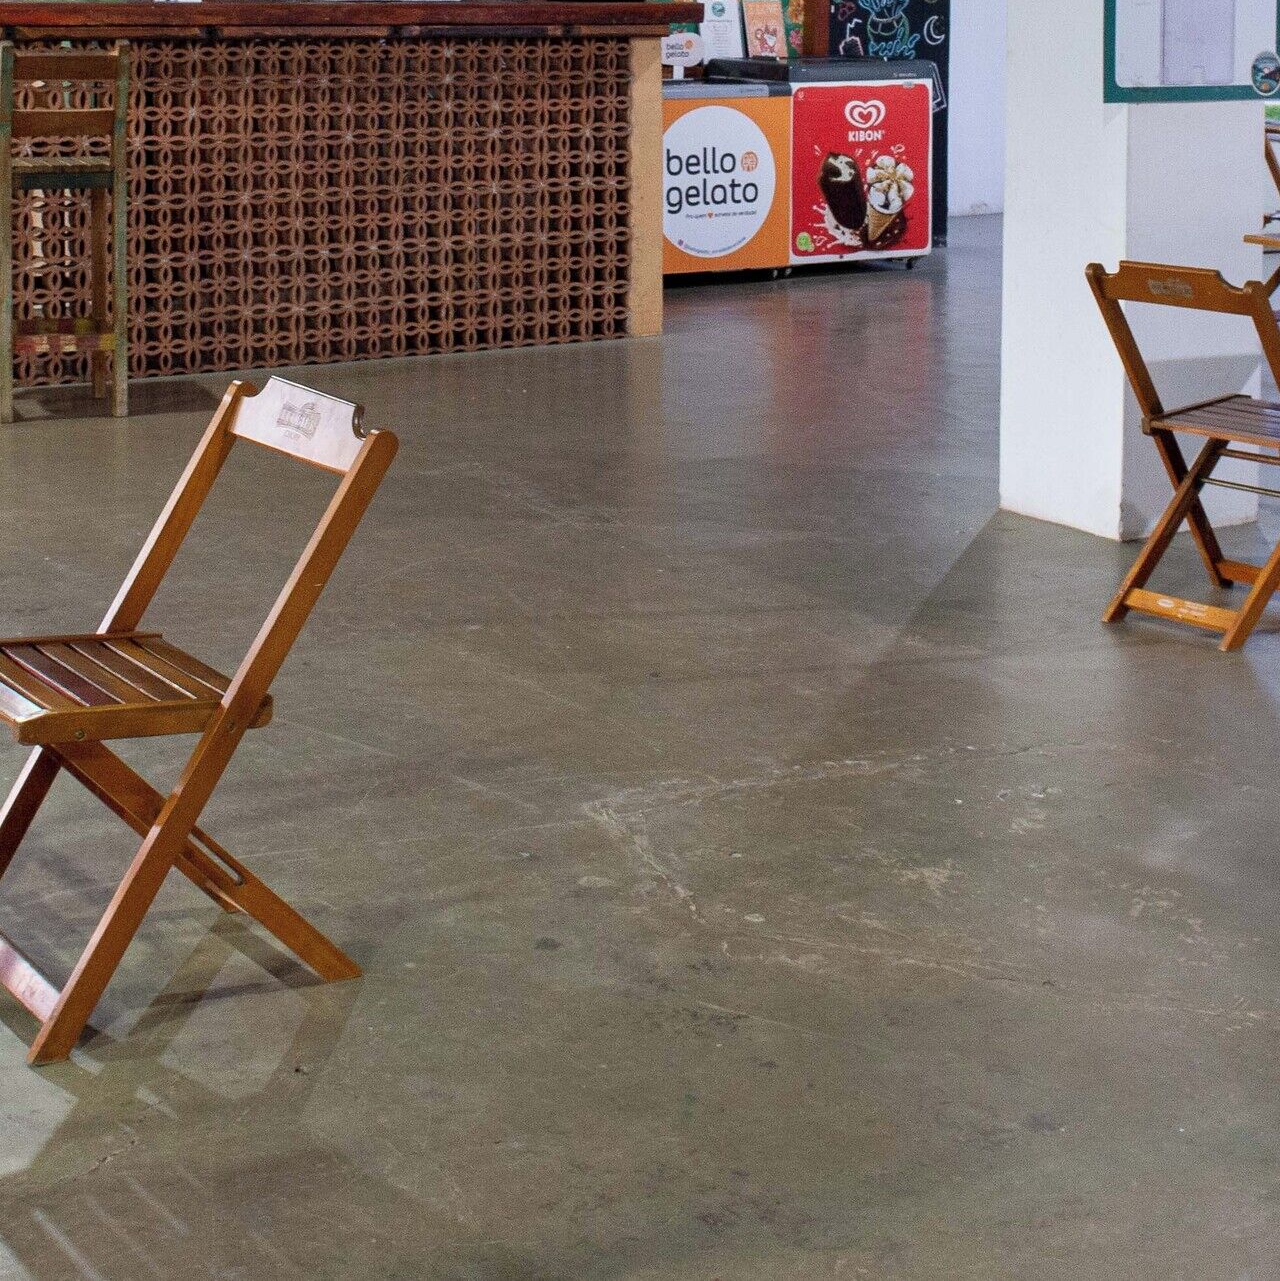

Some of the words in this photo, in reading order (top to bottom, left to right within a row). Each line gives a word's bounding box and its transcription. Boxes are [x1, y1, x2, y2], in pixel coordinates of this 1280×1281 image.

[666, 43, 684, 51] bello
[665, 50, 690, 59] gelato
[847, 130, 882, 142] KIBON
[666, 146, 737, 176] bello
[666, 178, 759, 214] gelato
